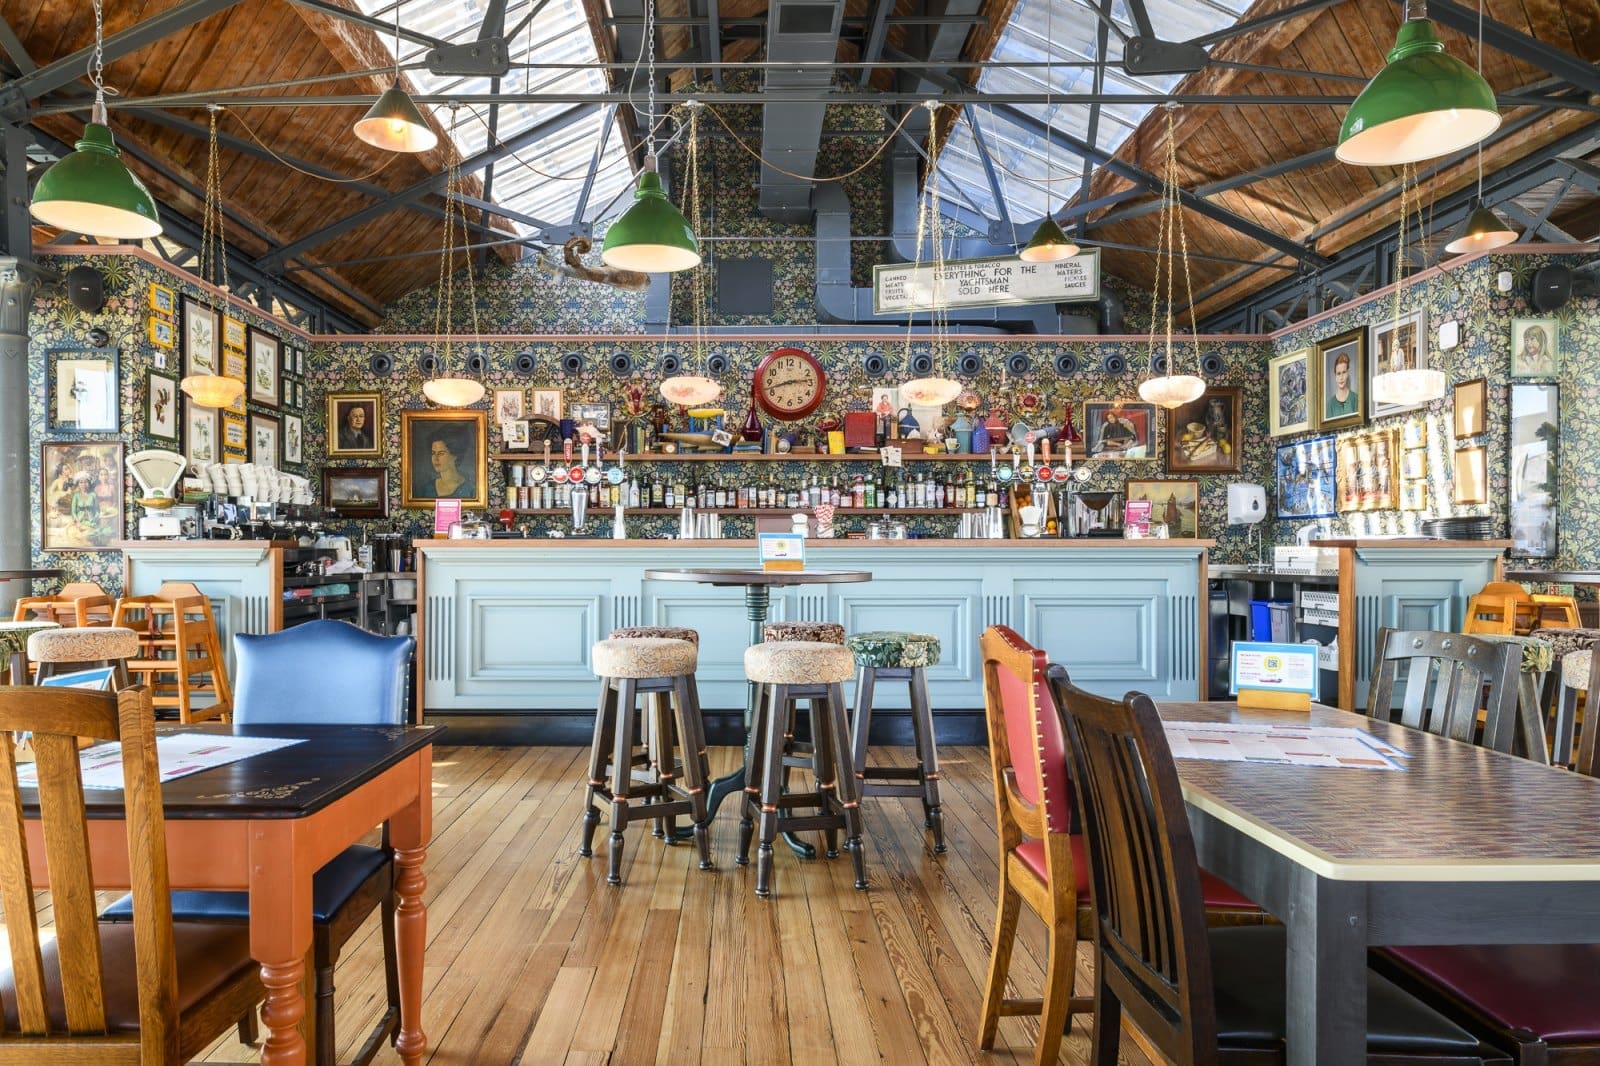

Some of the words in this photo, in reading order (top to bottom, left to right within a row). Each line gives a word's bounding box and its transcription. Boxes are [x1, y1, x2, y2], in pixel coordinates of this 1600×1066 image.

[934, 270, 986, 280] EVERYTHING
[994, 268, 1012, 276] FOR
[1021, 265, 1036, 274] THE
[960, 277, 1009, 287] YACHTSMAN
[959, 287, 980, 295] SOLD
[989, 285, 1009, 293] HERE
[786, 358, 794, 366] 12
